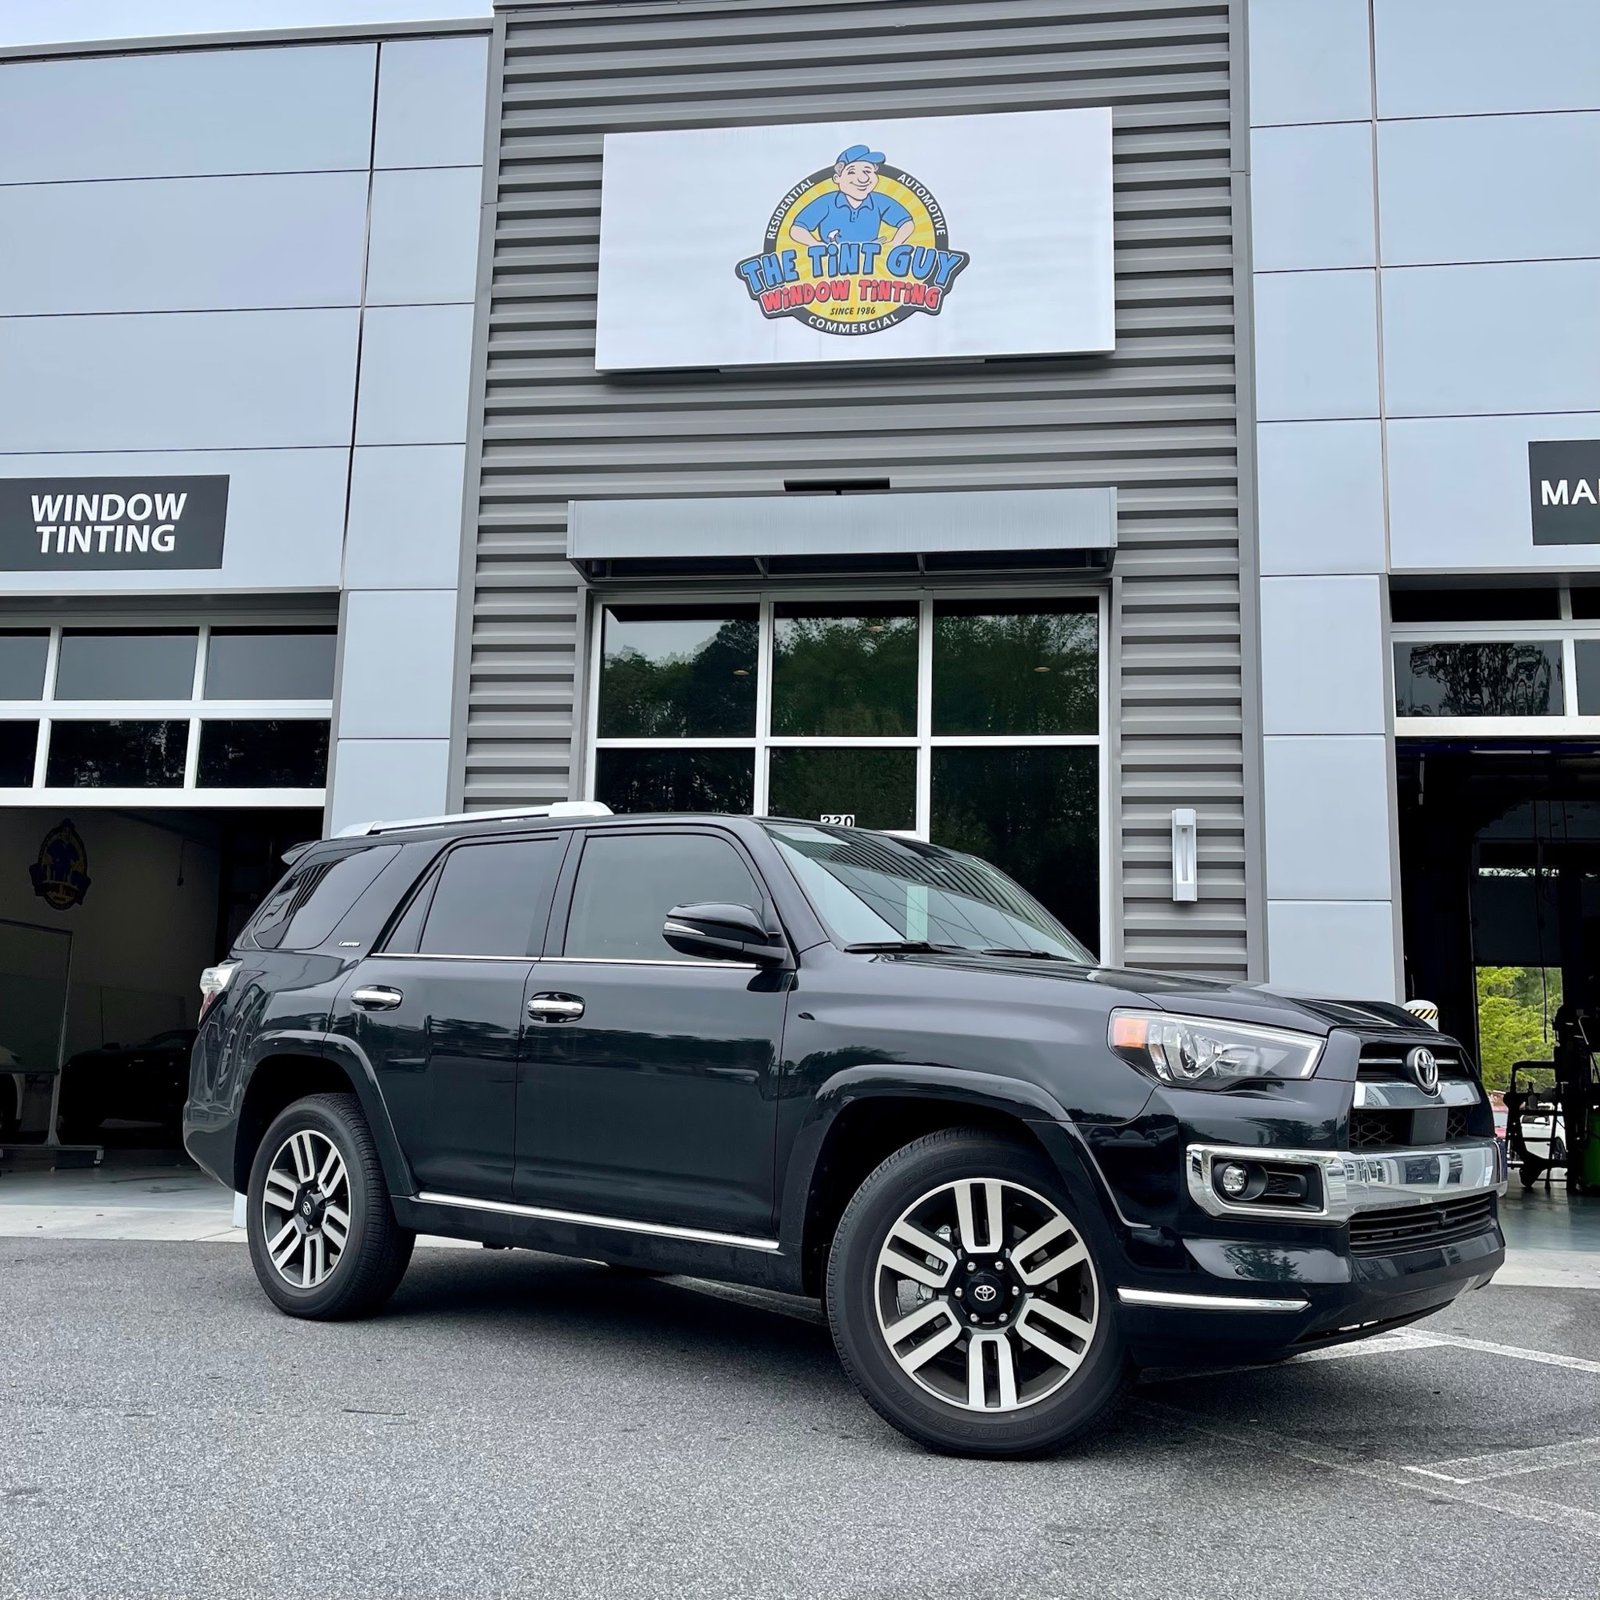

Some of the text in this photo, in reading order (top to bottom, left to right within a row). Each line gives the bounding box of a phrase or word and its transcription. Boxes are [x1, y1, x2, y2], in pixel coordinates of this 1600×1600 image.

[766, 179, 815, 240] RESIDENTIAL
[896, 173, 947, 236] AUTOMOTIVE
[741, 249, 800, 294] THE
[886, 244, 963, 286] GUY
[808, 314, 899, 333] COMMERCIAL
[830, 306, 876, 316] SINCE 1986
[1541, 478, 1600, 506] MA
[31, 493, 187, 522] WINDOW
[36, 524, 175, 553] TINTING
